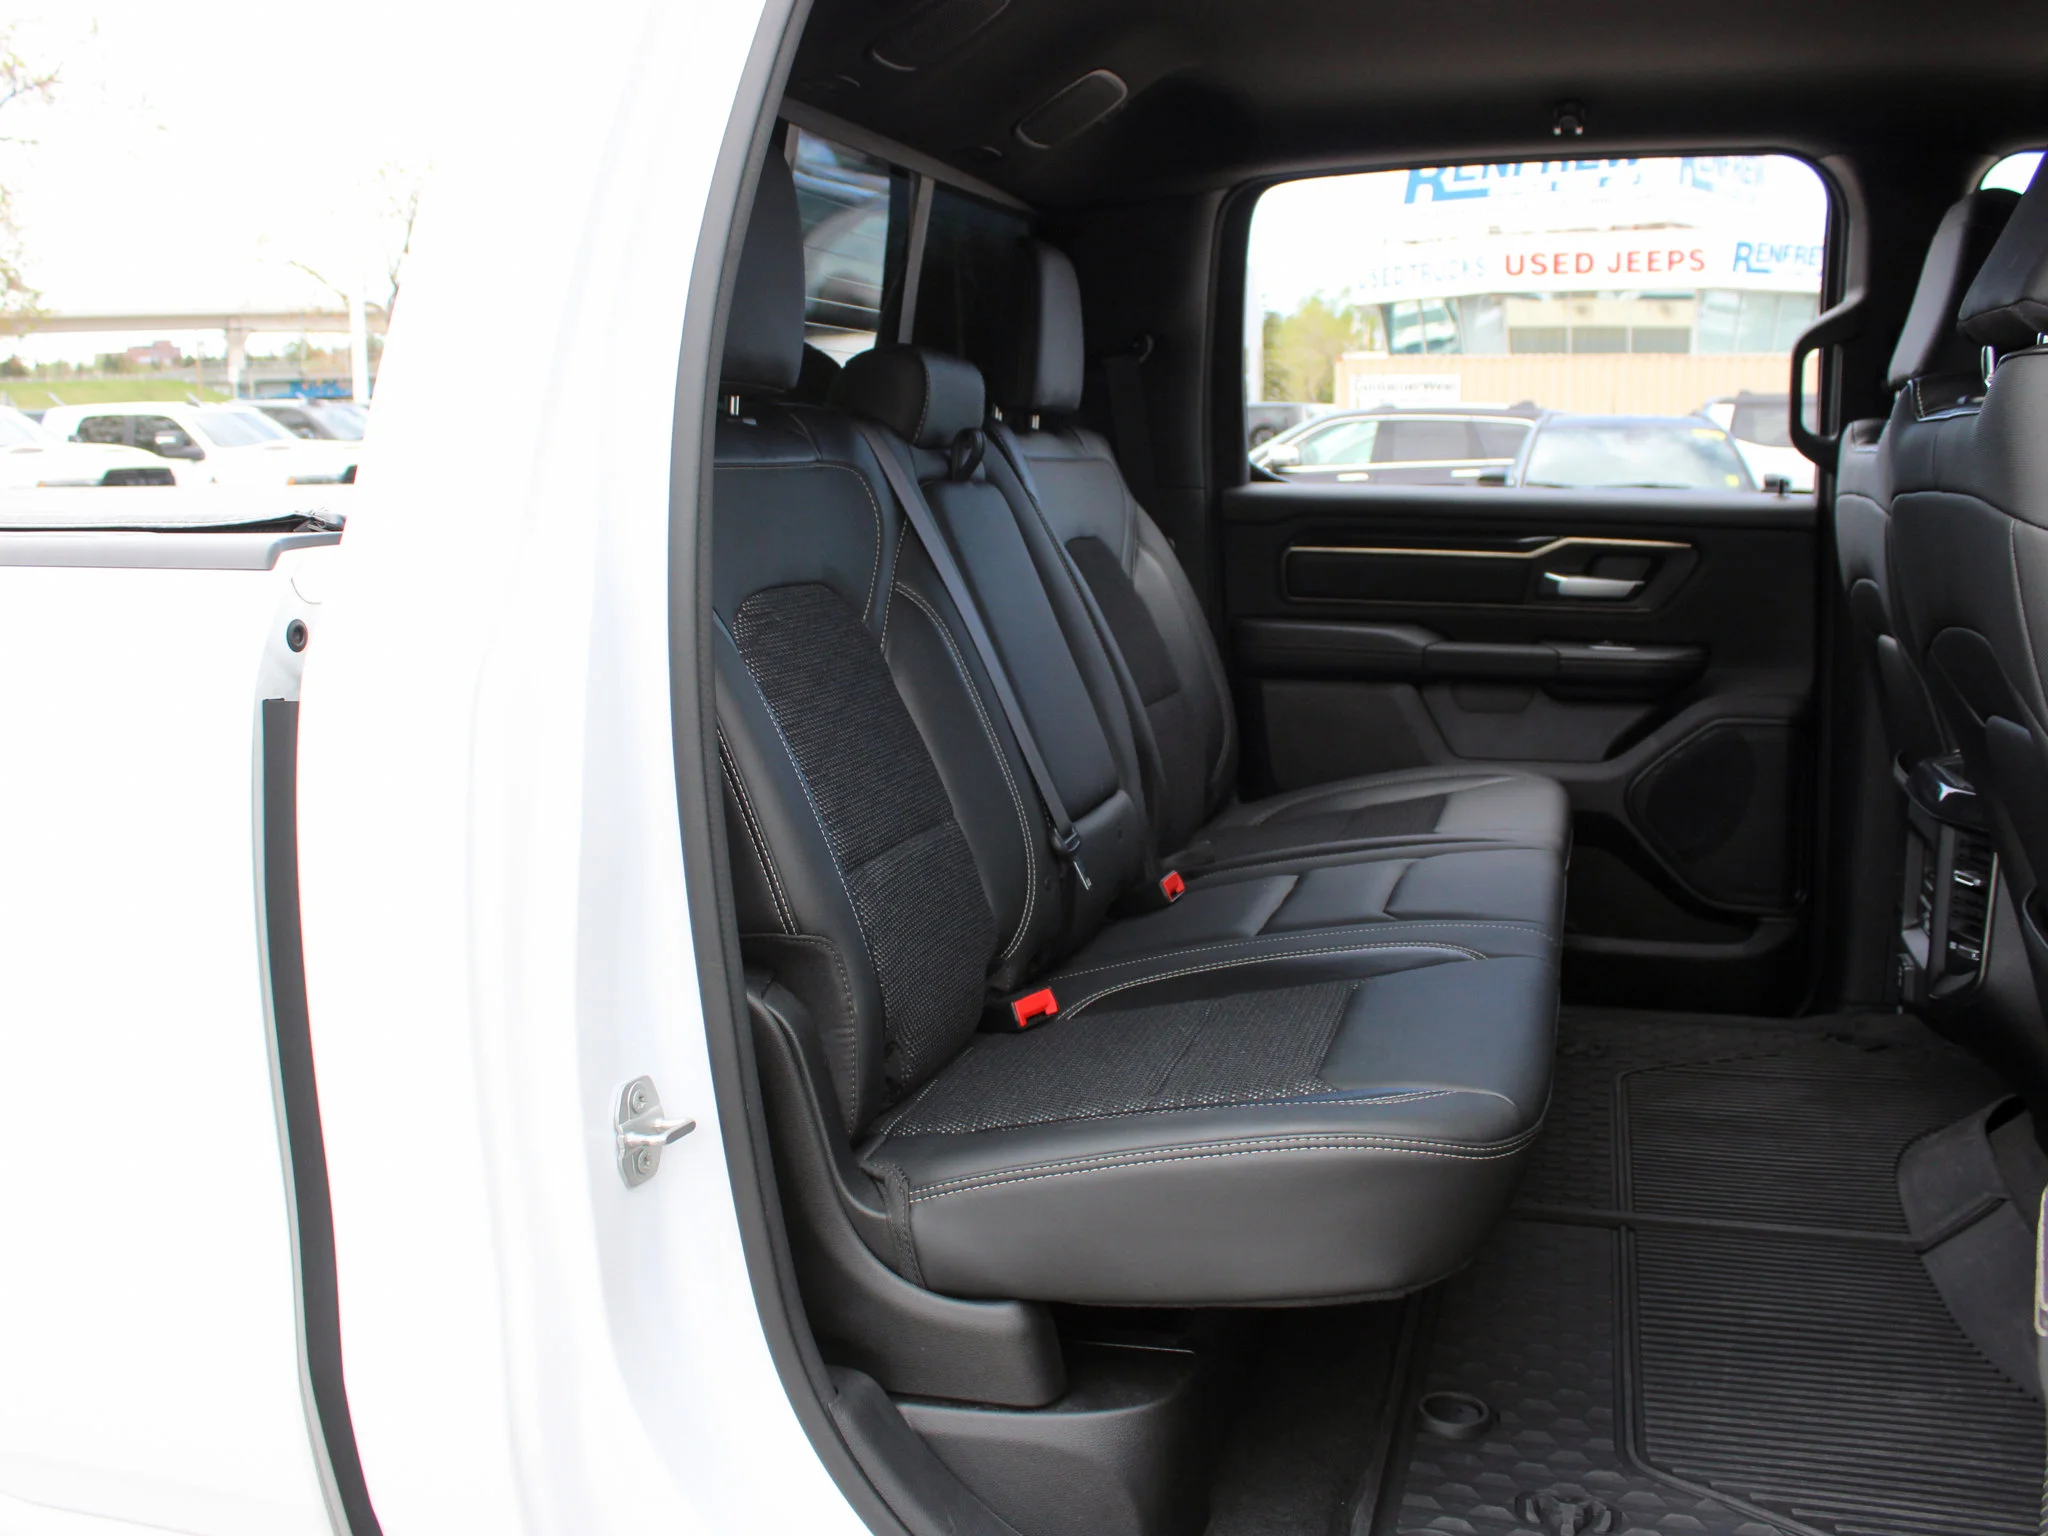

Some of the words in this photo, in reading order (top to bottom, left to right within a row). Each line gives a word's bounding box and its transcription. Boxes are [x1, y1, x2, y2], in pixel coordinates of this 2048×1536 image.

[1504, 252, 1595, 277] USED
[1607, 248, 1705, 274] JEEPS
[1732, 240, 1823, 275] RENFRE
